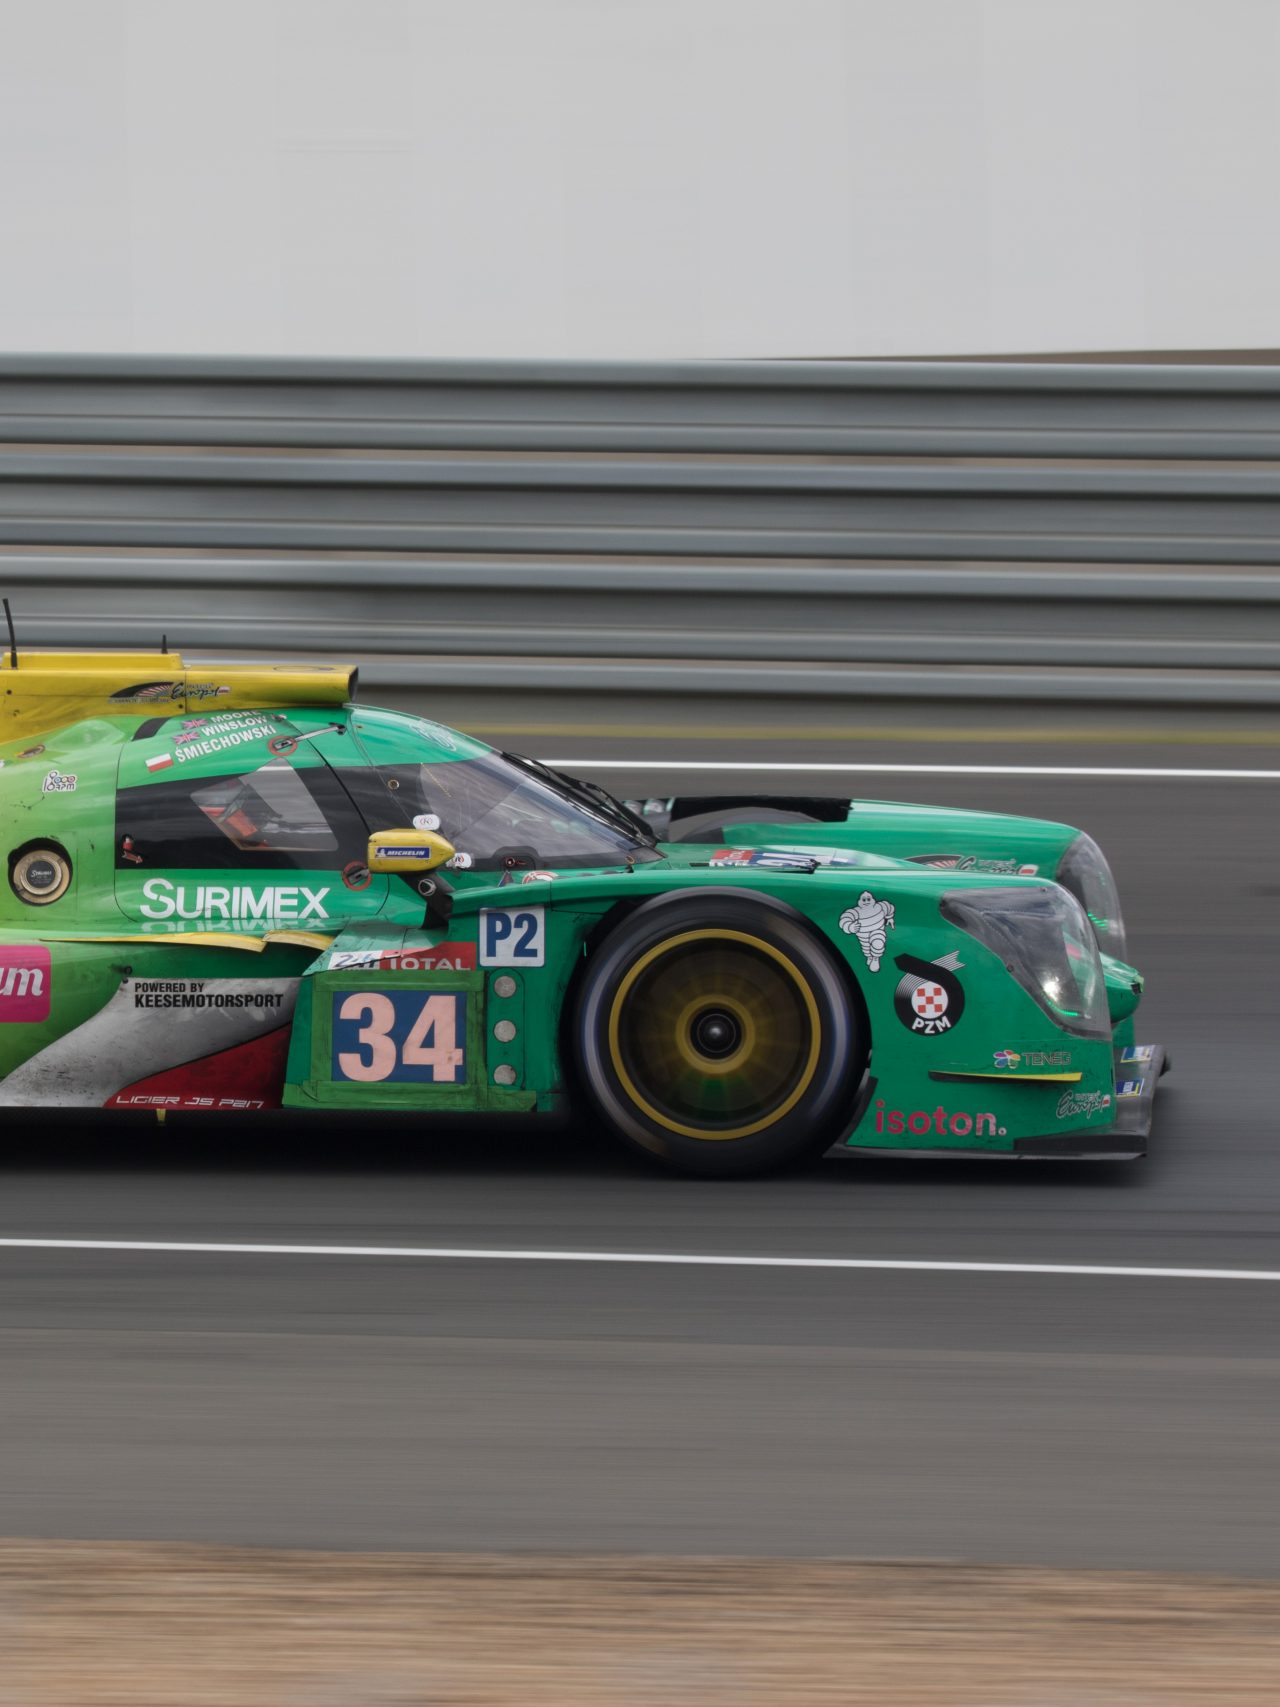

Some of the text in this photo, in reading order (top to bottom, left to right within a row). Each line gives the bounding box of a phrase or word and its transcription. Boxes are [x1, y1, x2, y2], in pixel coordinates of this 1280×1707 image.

[201, 716, 268, 737] WINSLOW
[175, 724, 277, 763] ŚMIECHOWSKI
[387, 849, 425, 857] MICHELIN
[140, 878, 330, 919] SURIMEX
[486, 913, 538, 957] P2
[135, 982, 204, 993] POWERED BY
[135, 994, 283, 1009] KEESEMOTORSPORT
[911, 1015, 952, 1034] PZM
[338, 992, 463, 1083] 34
[1021, 1052, 1071, 1066] TENEG
[116, 1095, 265, 1109] LIGIER JS P217
